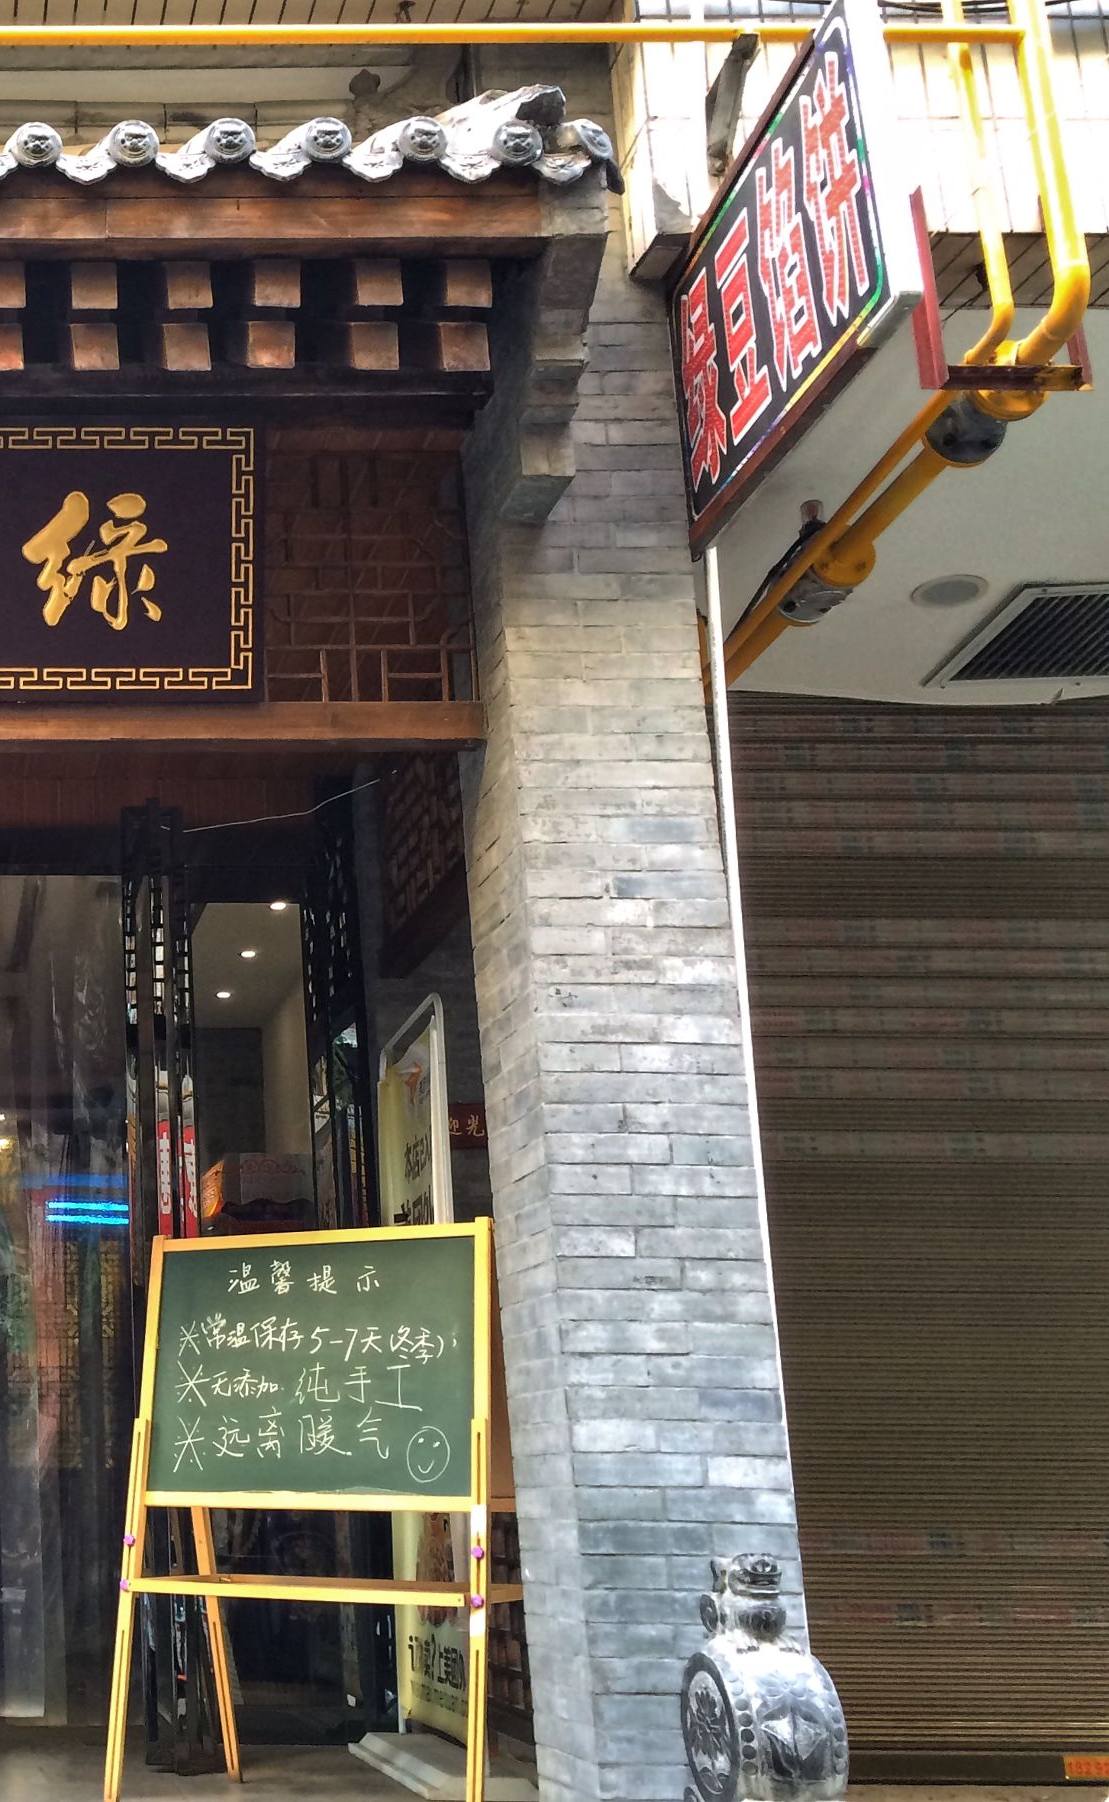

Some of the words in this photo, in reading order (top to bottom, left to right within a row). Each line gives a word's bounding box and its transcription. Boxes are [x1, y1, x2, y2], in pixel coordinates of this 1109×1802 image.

[679, 51, 870, 494] 绿豆馅饼
[227, 1260, 380, 1295] 温馨提示
[214, 1405, 390, 1460] 远离暖气
